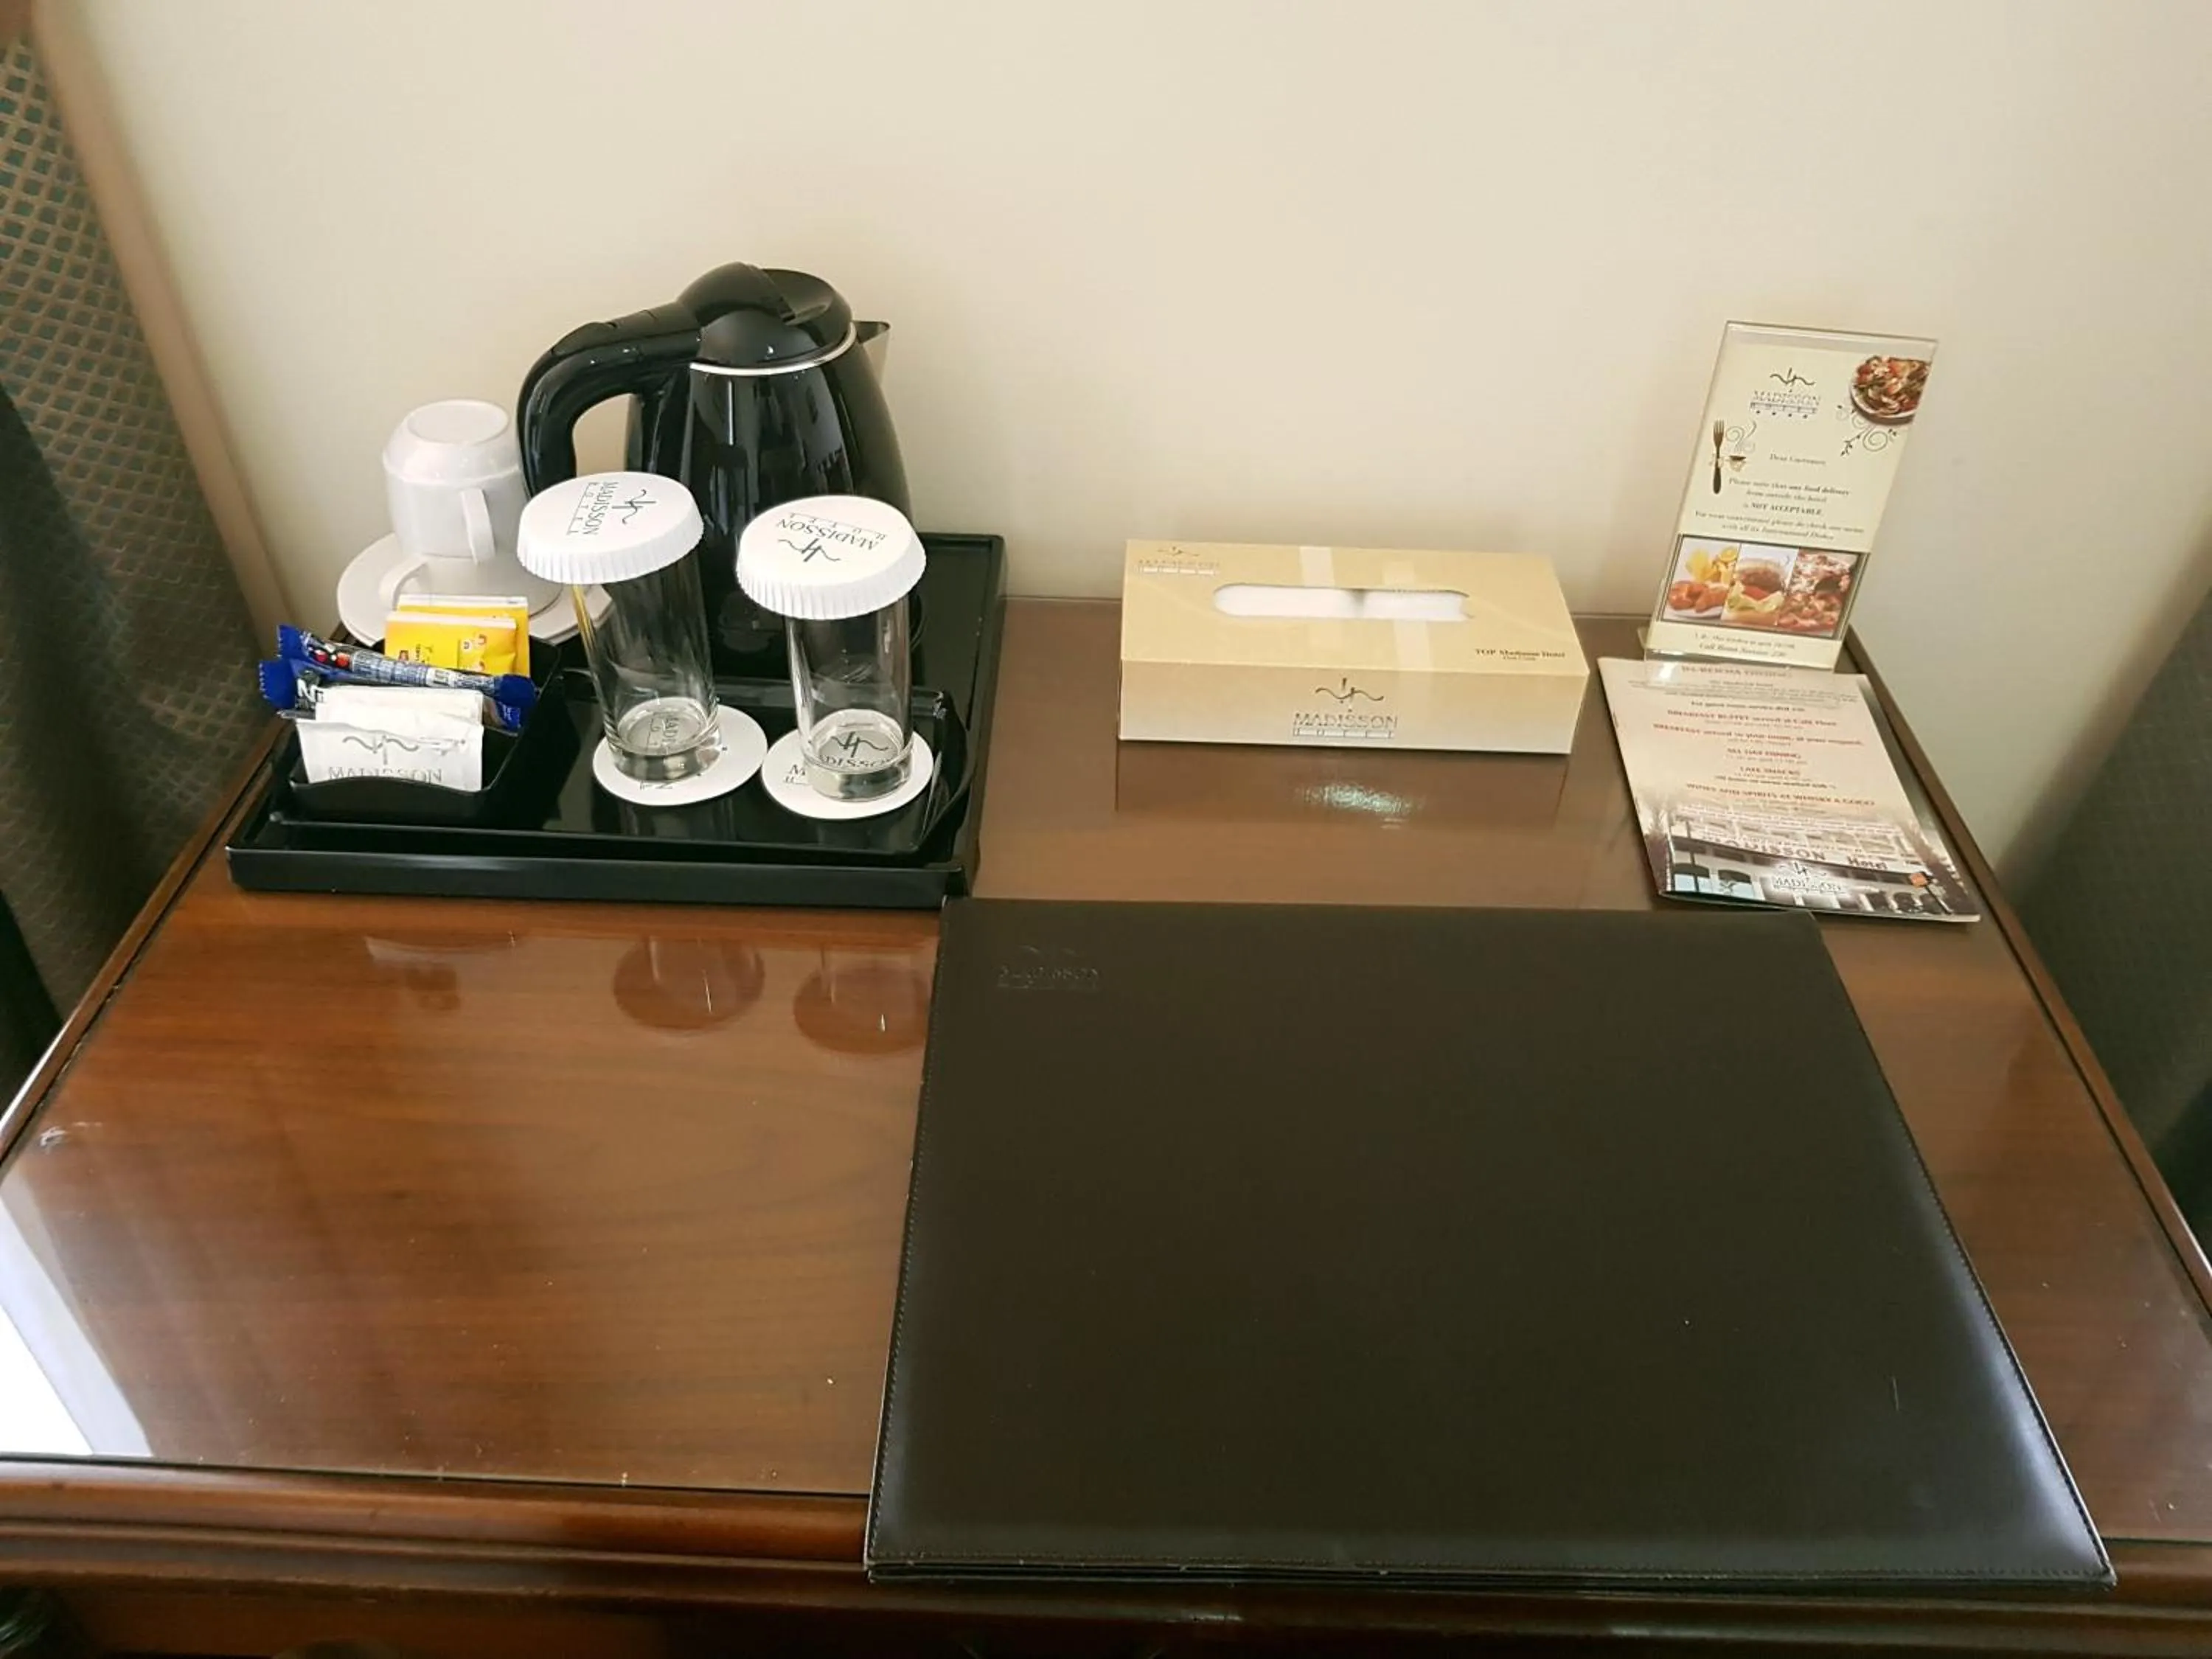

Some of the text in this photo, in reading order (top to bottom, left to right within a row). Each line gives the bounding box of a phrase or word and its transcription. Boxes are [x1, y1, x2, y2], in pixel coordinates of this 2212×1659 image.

[583, 481, 619, 535] MADISSON
[776, 518, 880, 550] MADISSON
[1294, 712, 1398, 728] MADISSON
[1847, 855, 1888, 870] Hotel
